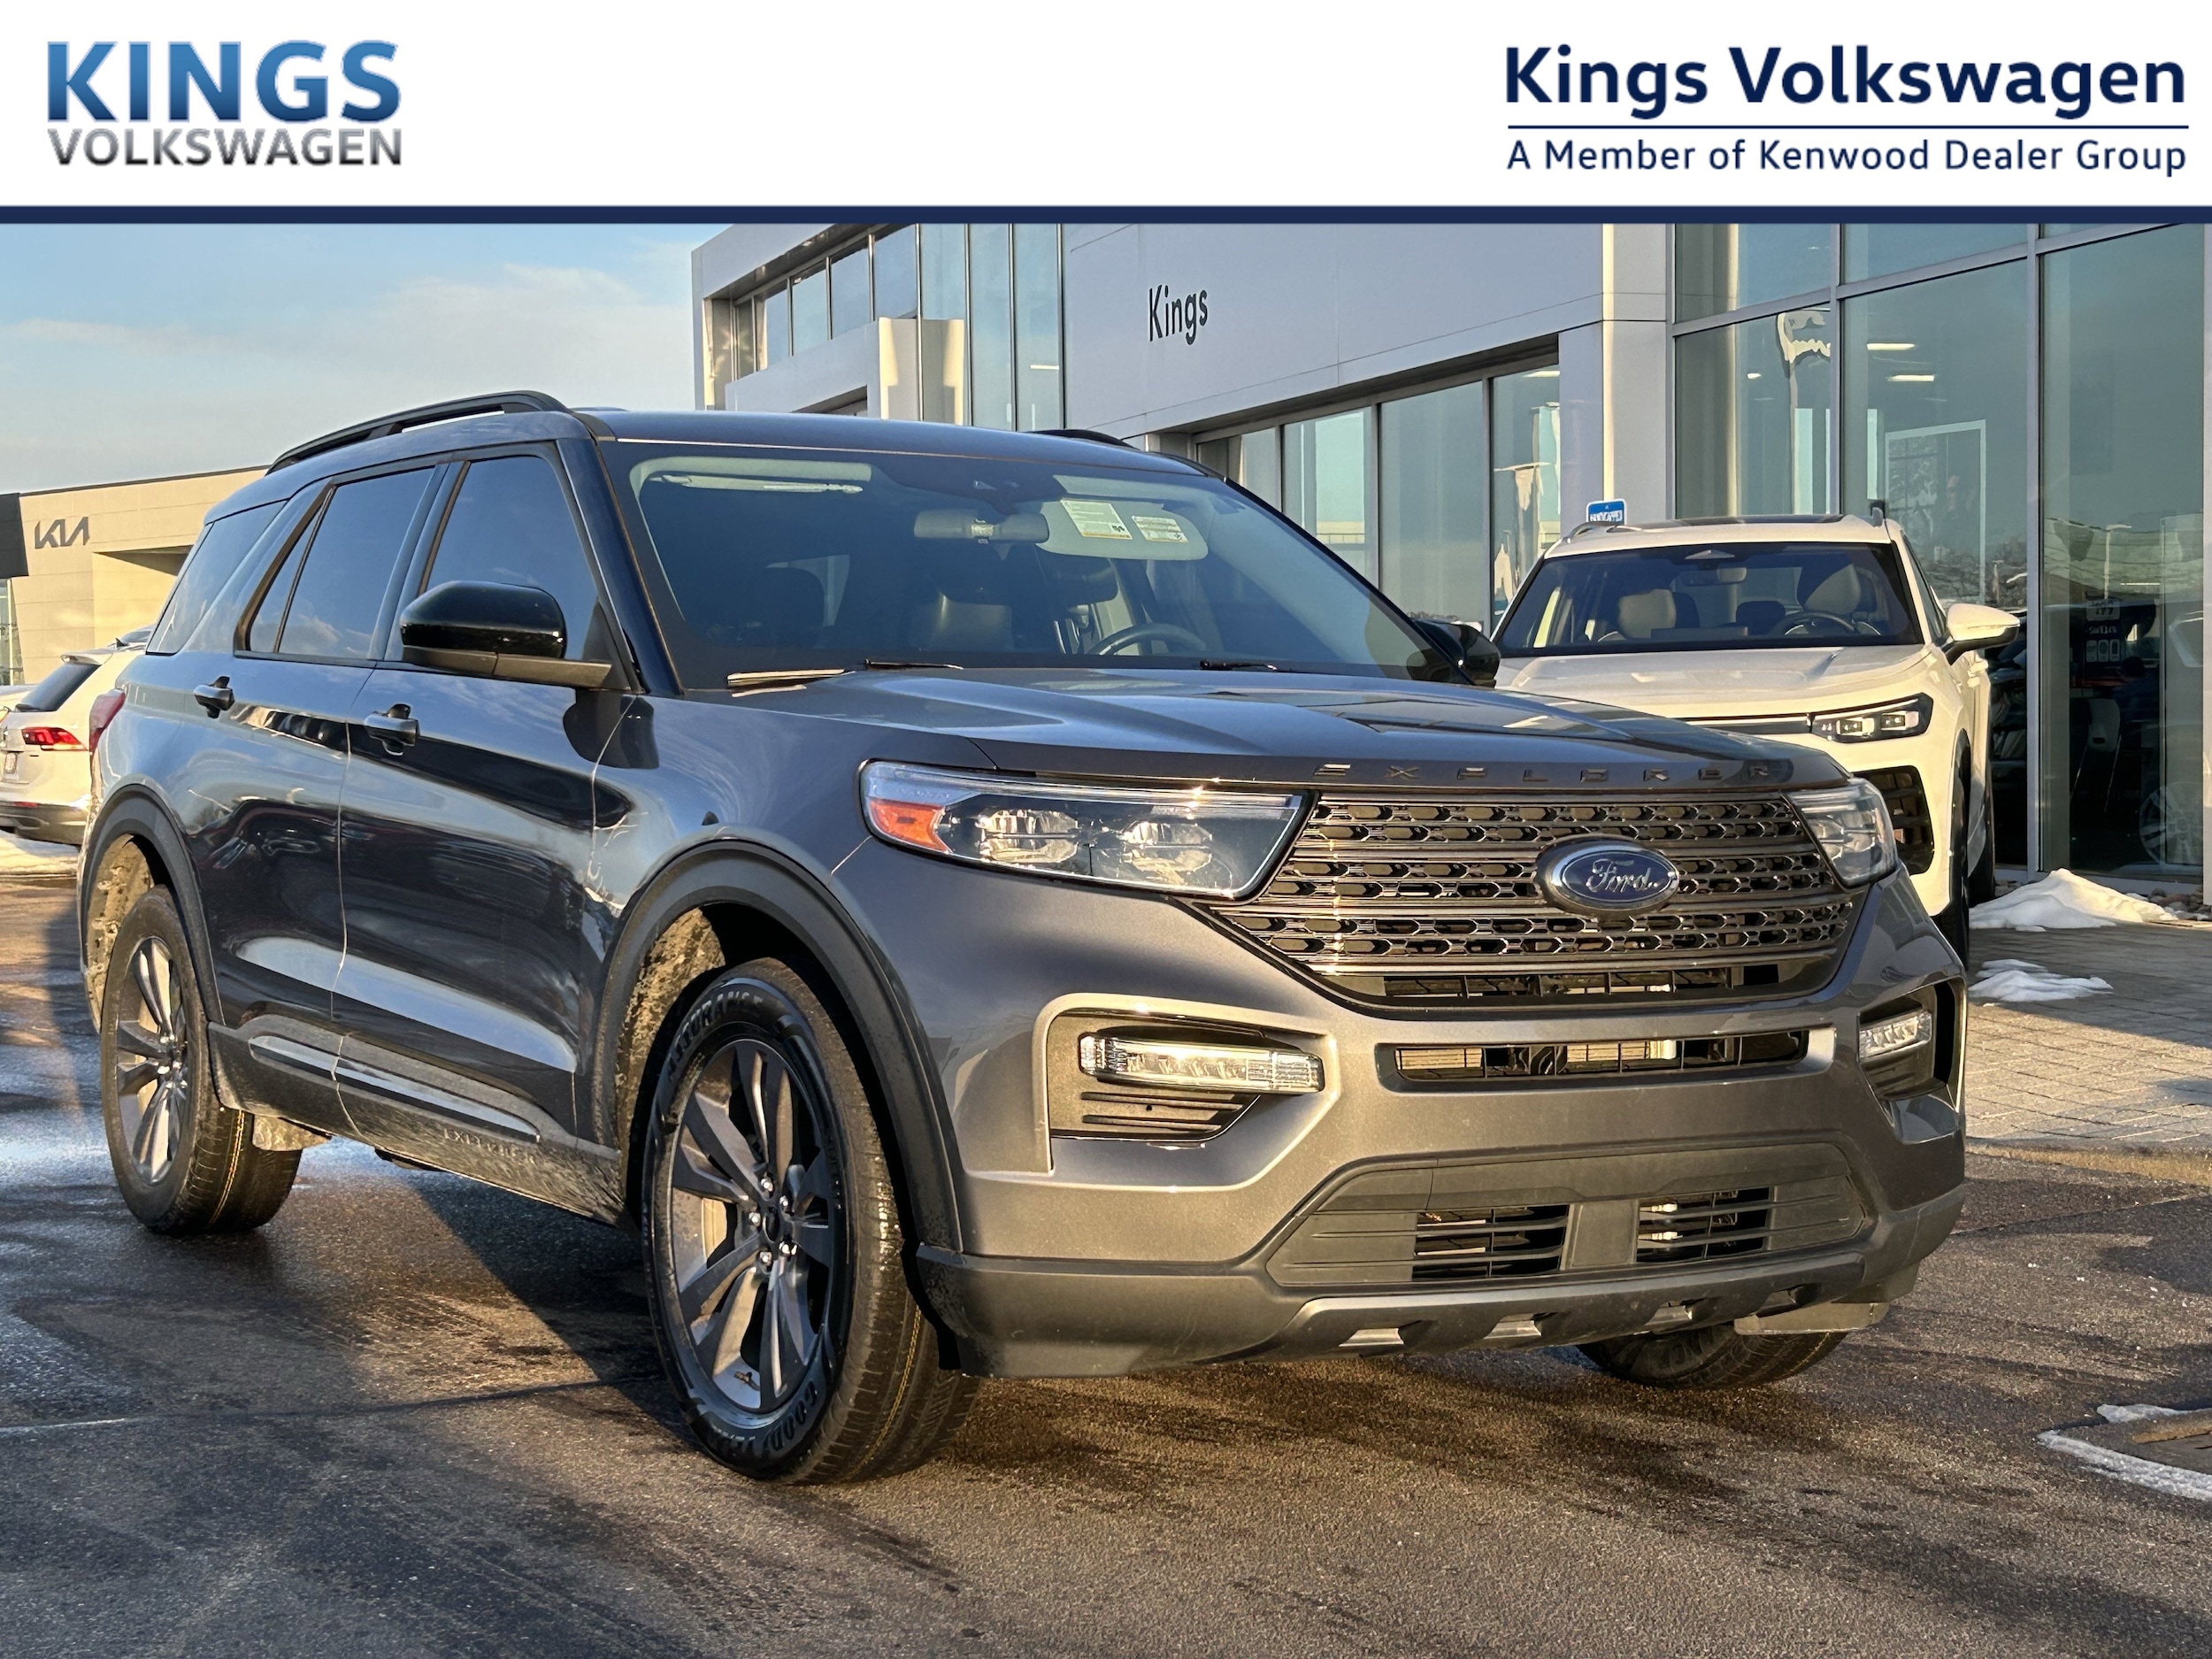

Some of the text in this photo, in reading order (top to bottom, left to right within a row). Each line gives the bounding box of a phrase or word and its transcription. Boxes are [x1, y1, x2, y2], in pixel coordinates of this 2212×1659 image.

[1148, 285, 1209, 345] Kings
[35, 516, 90, 549] KIA
[1313, 762, 1771, 782] EXPLORER
[1585, 858, 1655, 894] Ford
